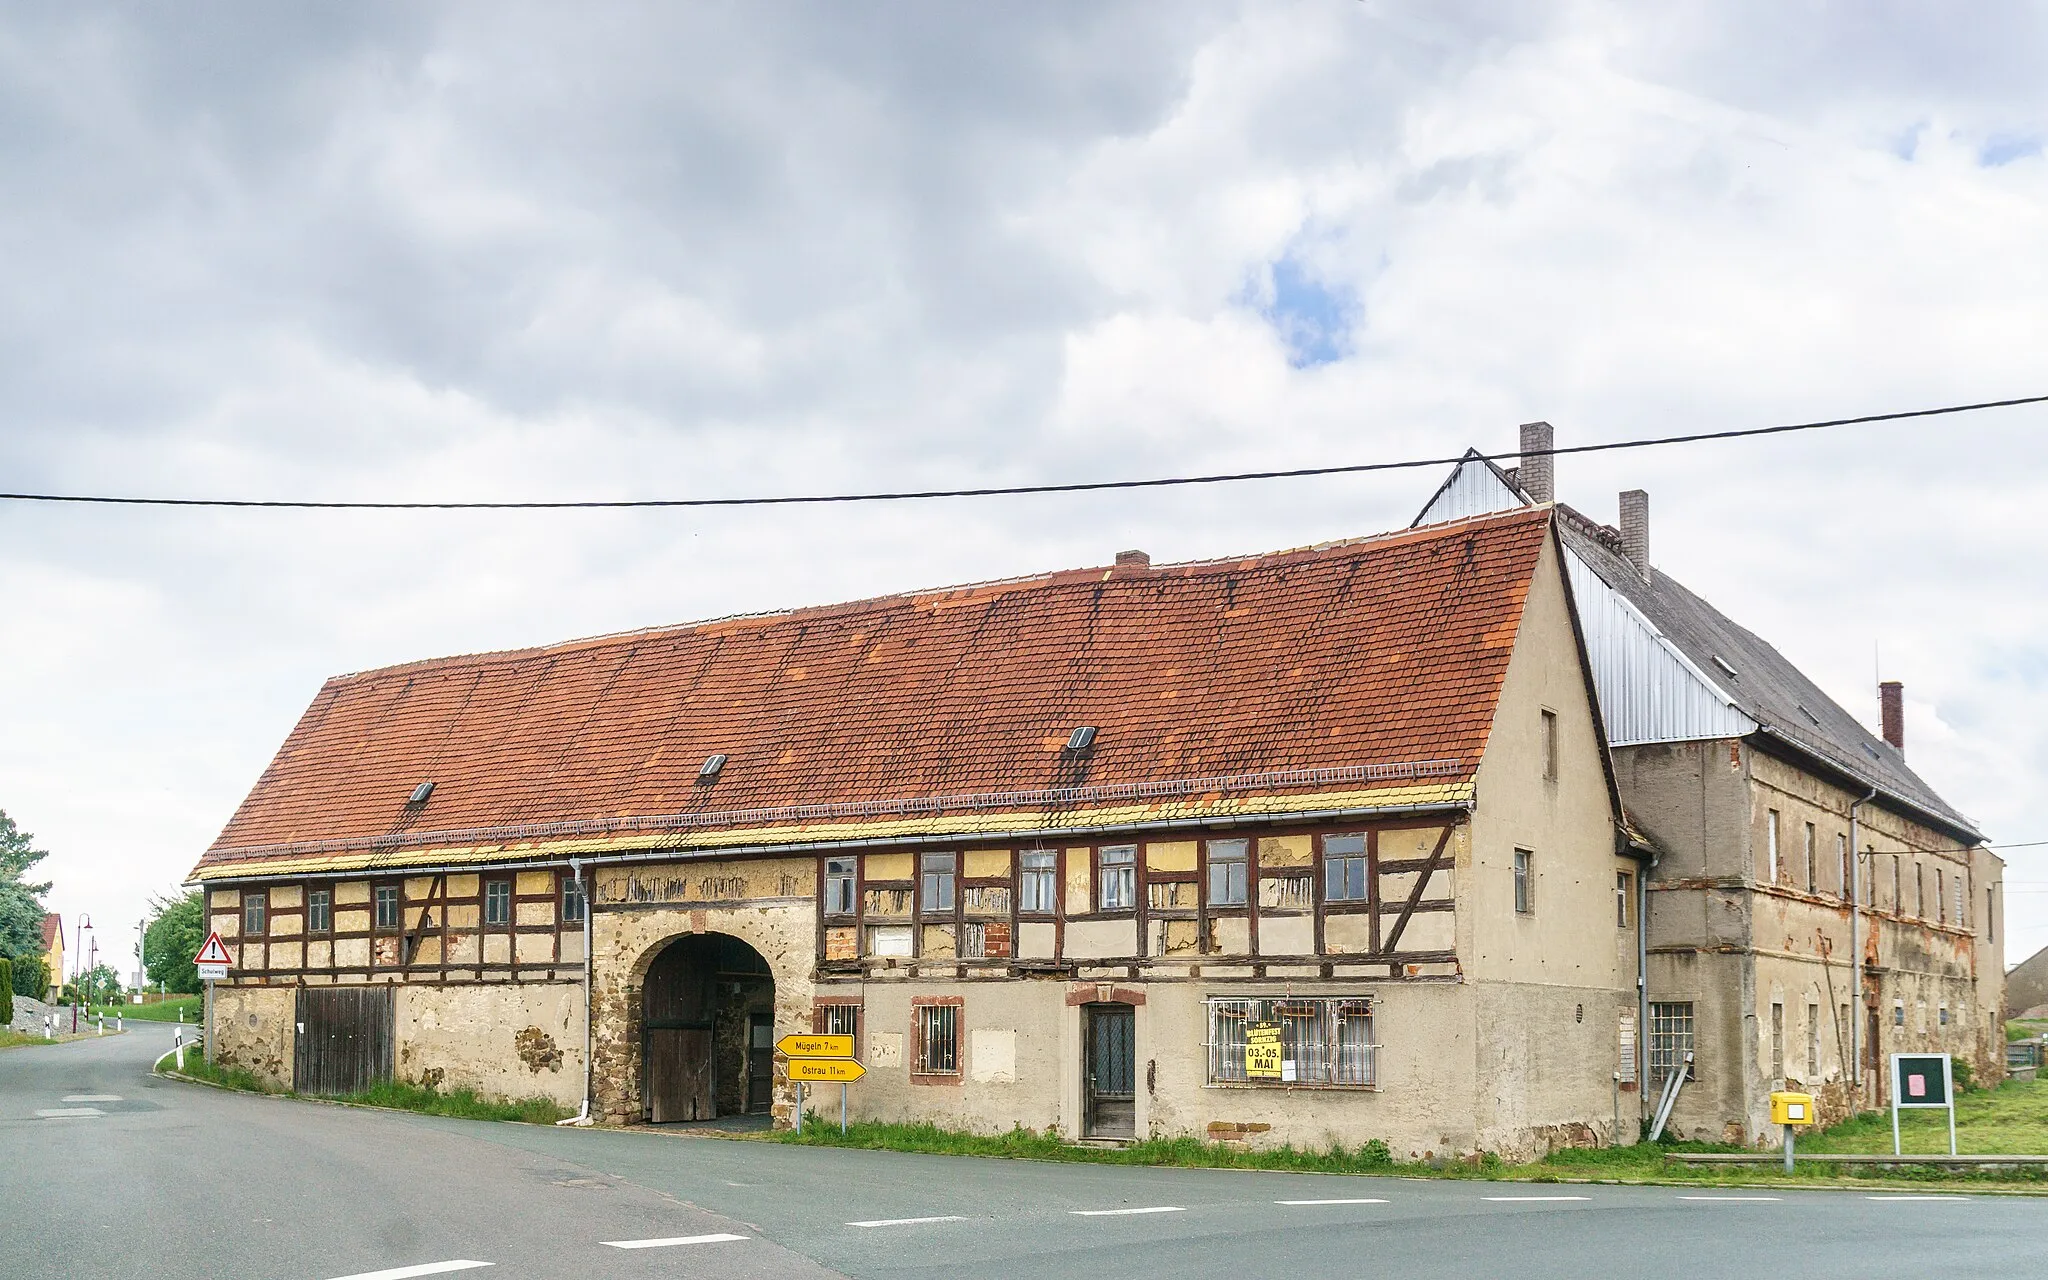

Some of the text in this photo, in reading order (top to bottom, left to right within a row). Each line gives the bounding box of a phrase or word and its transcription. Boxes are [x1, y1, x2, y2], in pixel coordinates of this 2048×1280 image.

[201, 968, 224, 976] Schulweg
[1246, 1028, 1281, 1038] BLÜTENFEST
[795, 1041, 839, 1052] Mügeln 7 km
[1254, 1059, 1274, 1069] MAI
[801, 1065, 846, 1076] Ostrau 11 km
